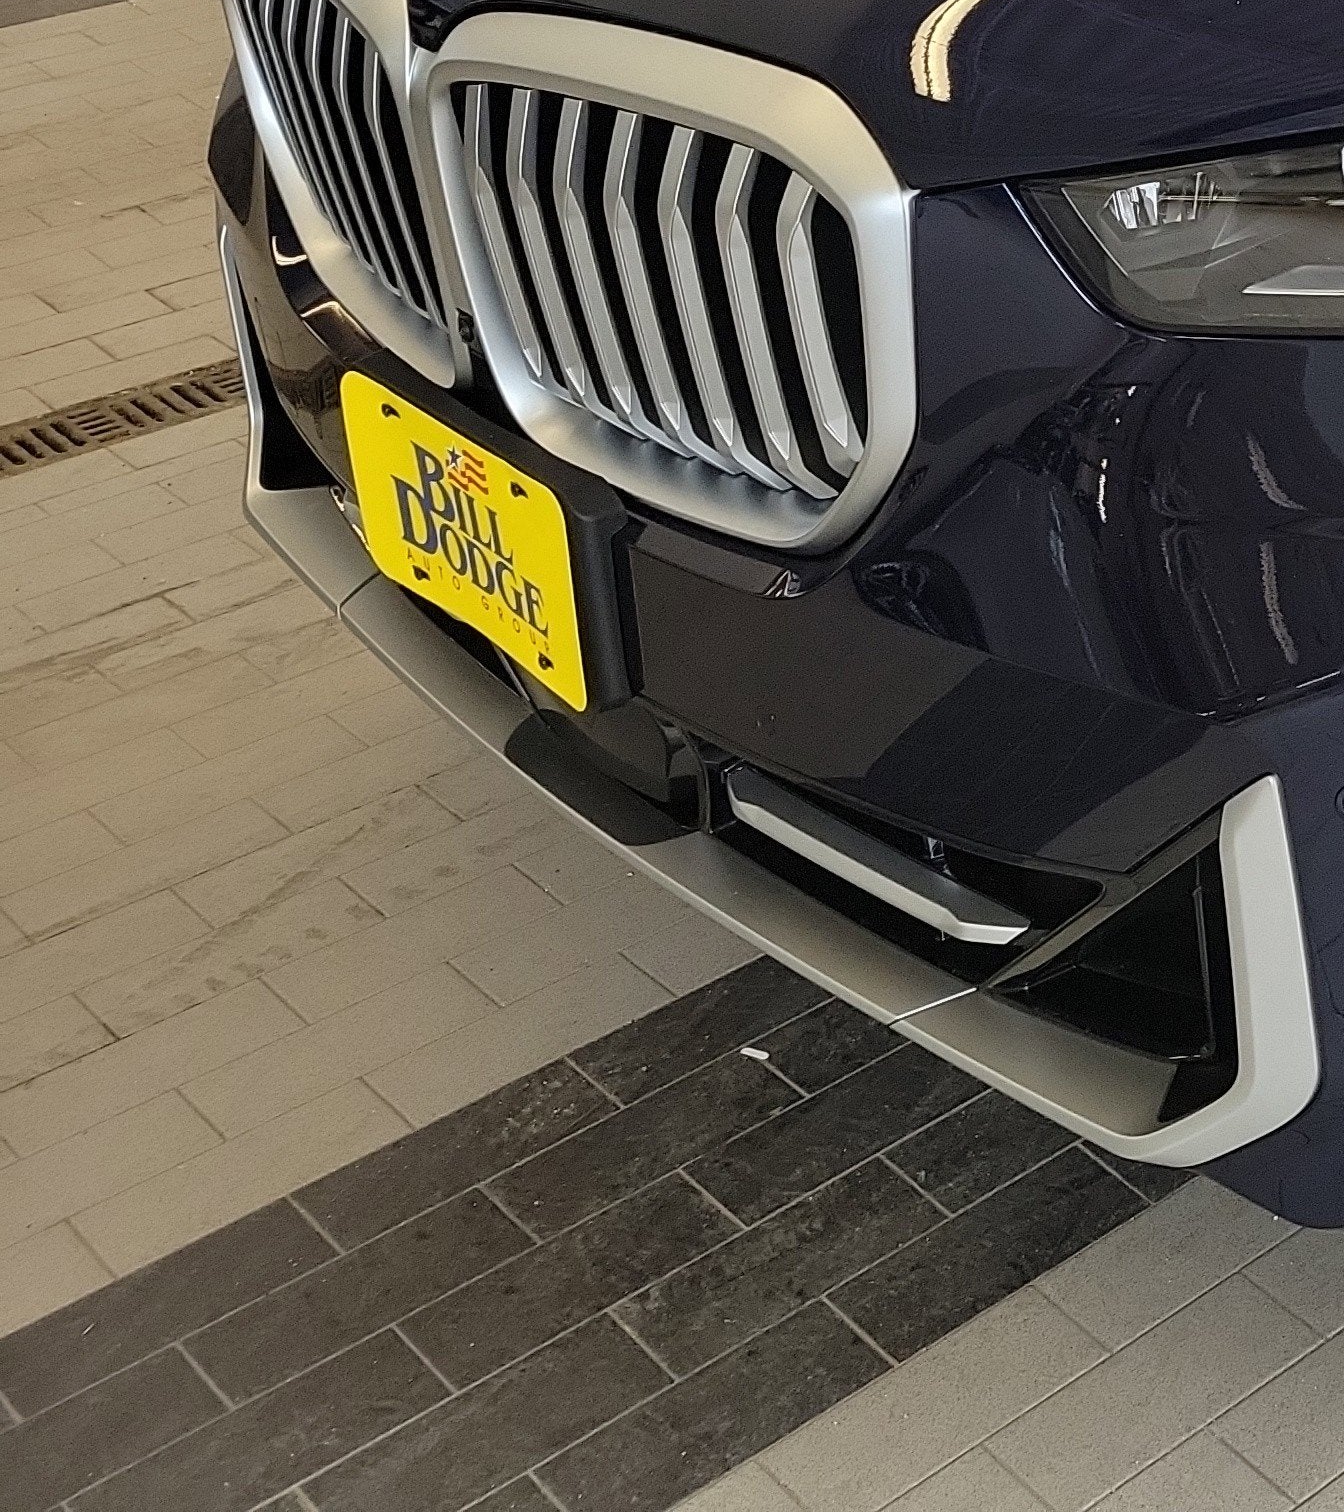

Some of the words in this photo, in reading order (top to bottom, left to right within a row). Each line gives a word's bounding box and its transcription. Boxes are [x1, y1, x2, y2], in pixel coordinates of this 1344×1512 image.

[410, 440, 513, 567] BILL
[390, 474, 549, 639] DODGE
[407, 547, 461, 592] AUTO
[481, 595, 550, 655] GROUP
